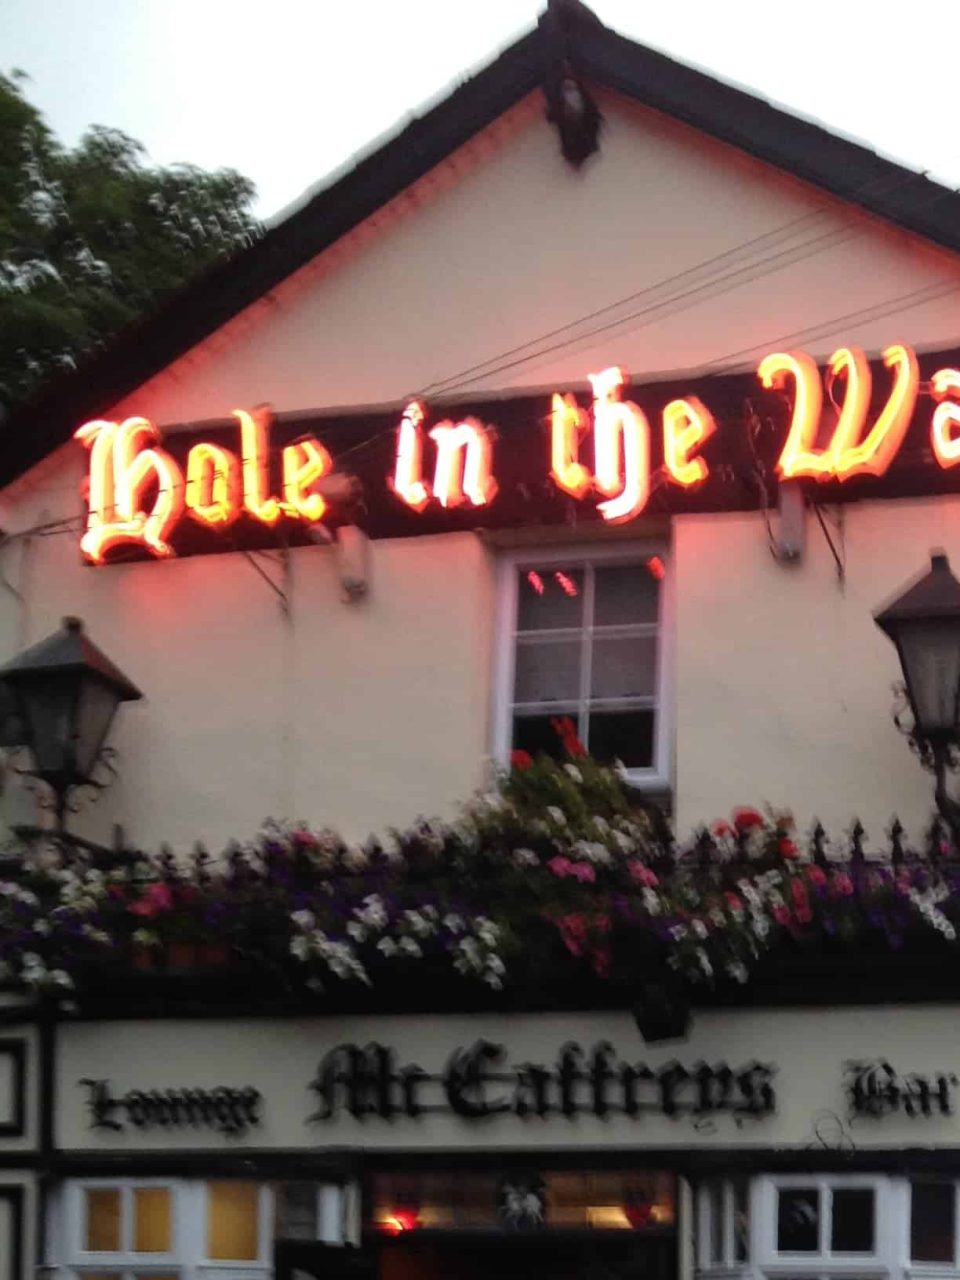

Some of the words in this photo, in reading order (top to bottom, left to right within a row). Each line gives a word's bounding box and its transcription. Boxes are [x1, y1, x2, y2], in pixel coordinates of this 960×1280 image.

[74, 404, 333, 565] Hole
[391, 402, 497, 511] in
[547, 365, 716, 522] the
[845, 1058, 960, 1122] Bar
